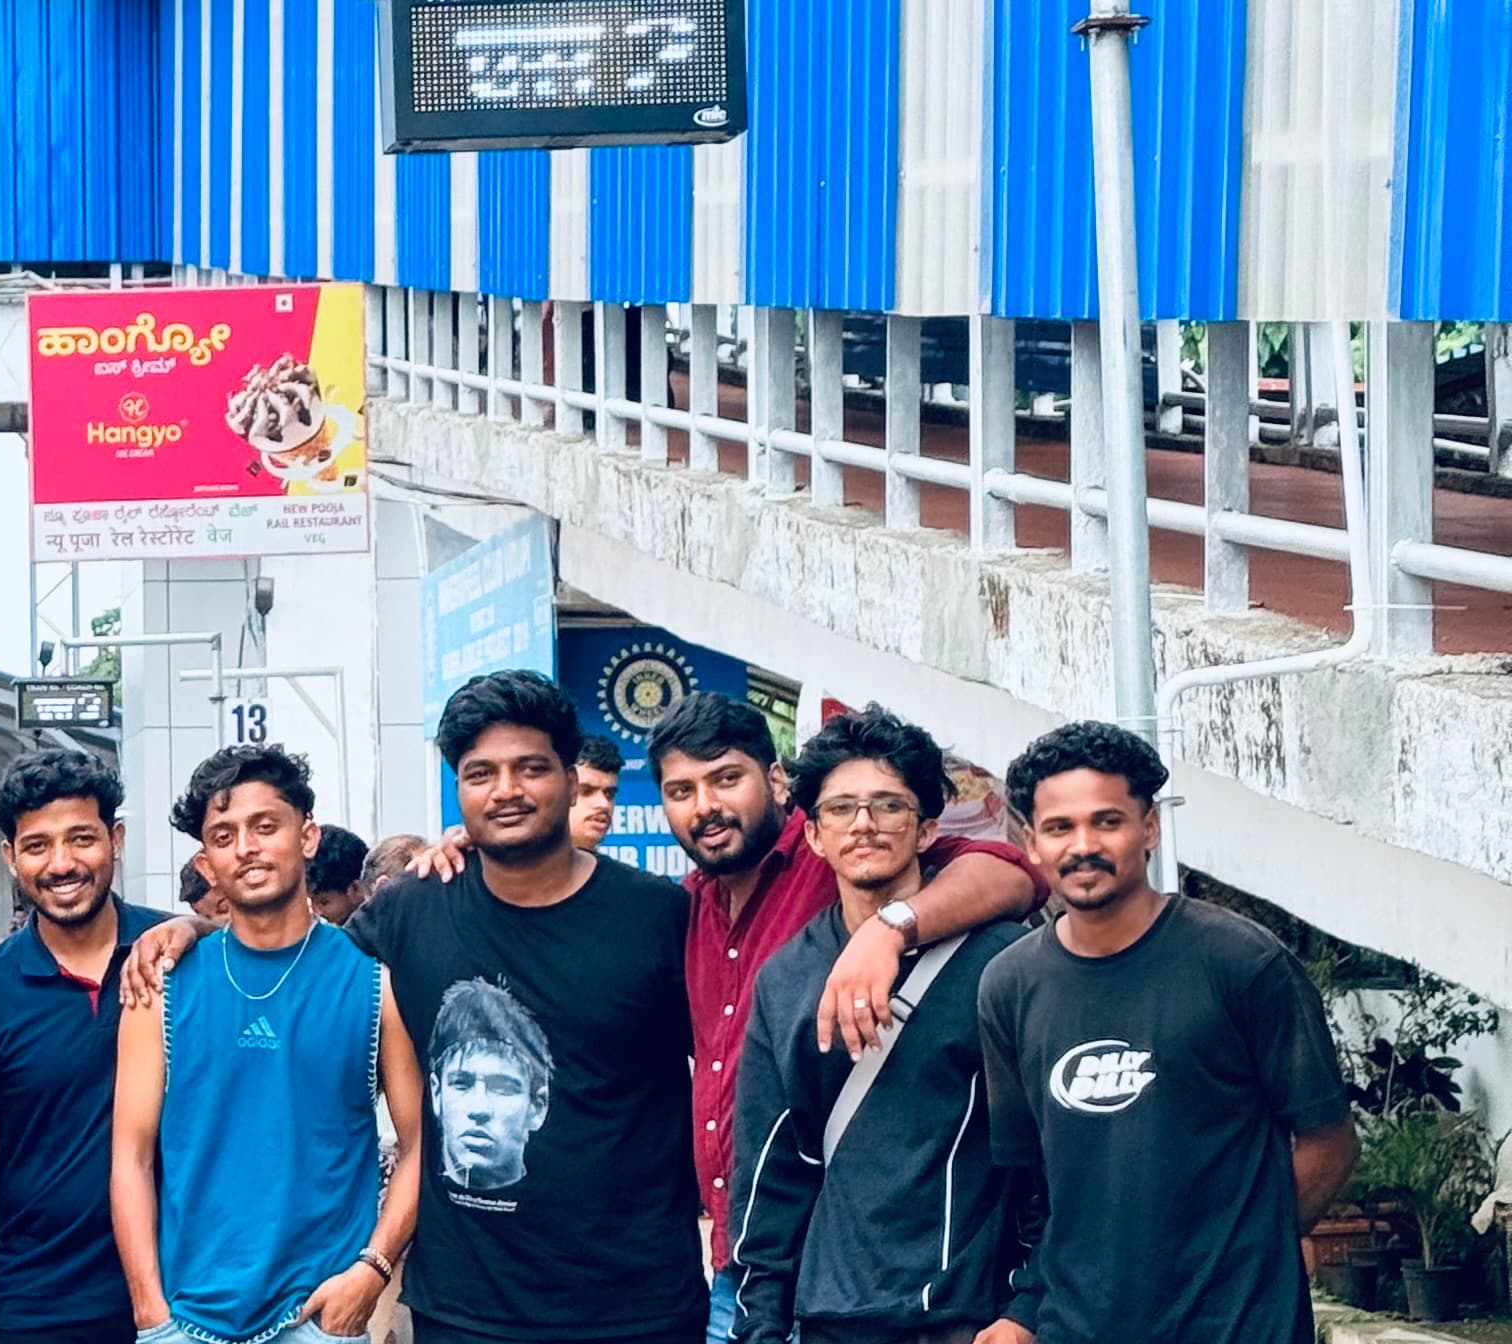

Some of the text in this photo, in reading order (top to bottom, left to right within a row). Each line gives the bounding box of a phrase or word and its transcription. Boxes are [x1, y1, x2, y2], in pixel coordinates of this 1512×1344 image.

[87, 421, 183, 449] Hangyo
[283, 501, 345, 514] NEW POOJA
[266, 514, 363, 529] RAIL RESTAURANT
[69, 532, 101, 553] पूजा
[109, 525, 134, 548] रेल
[206, 522, 234, 545] वेज
[303, 532, 327, 545] VEG
[231, 703, 267, 744] 13
